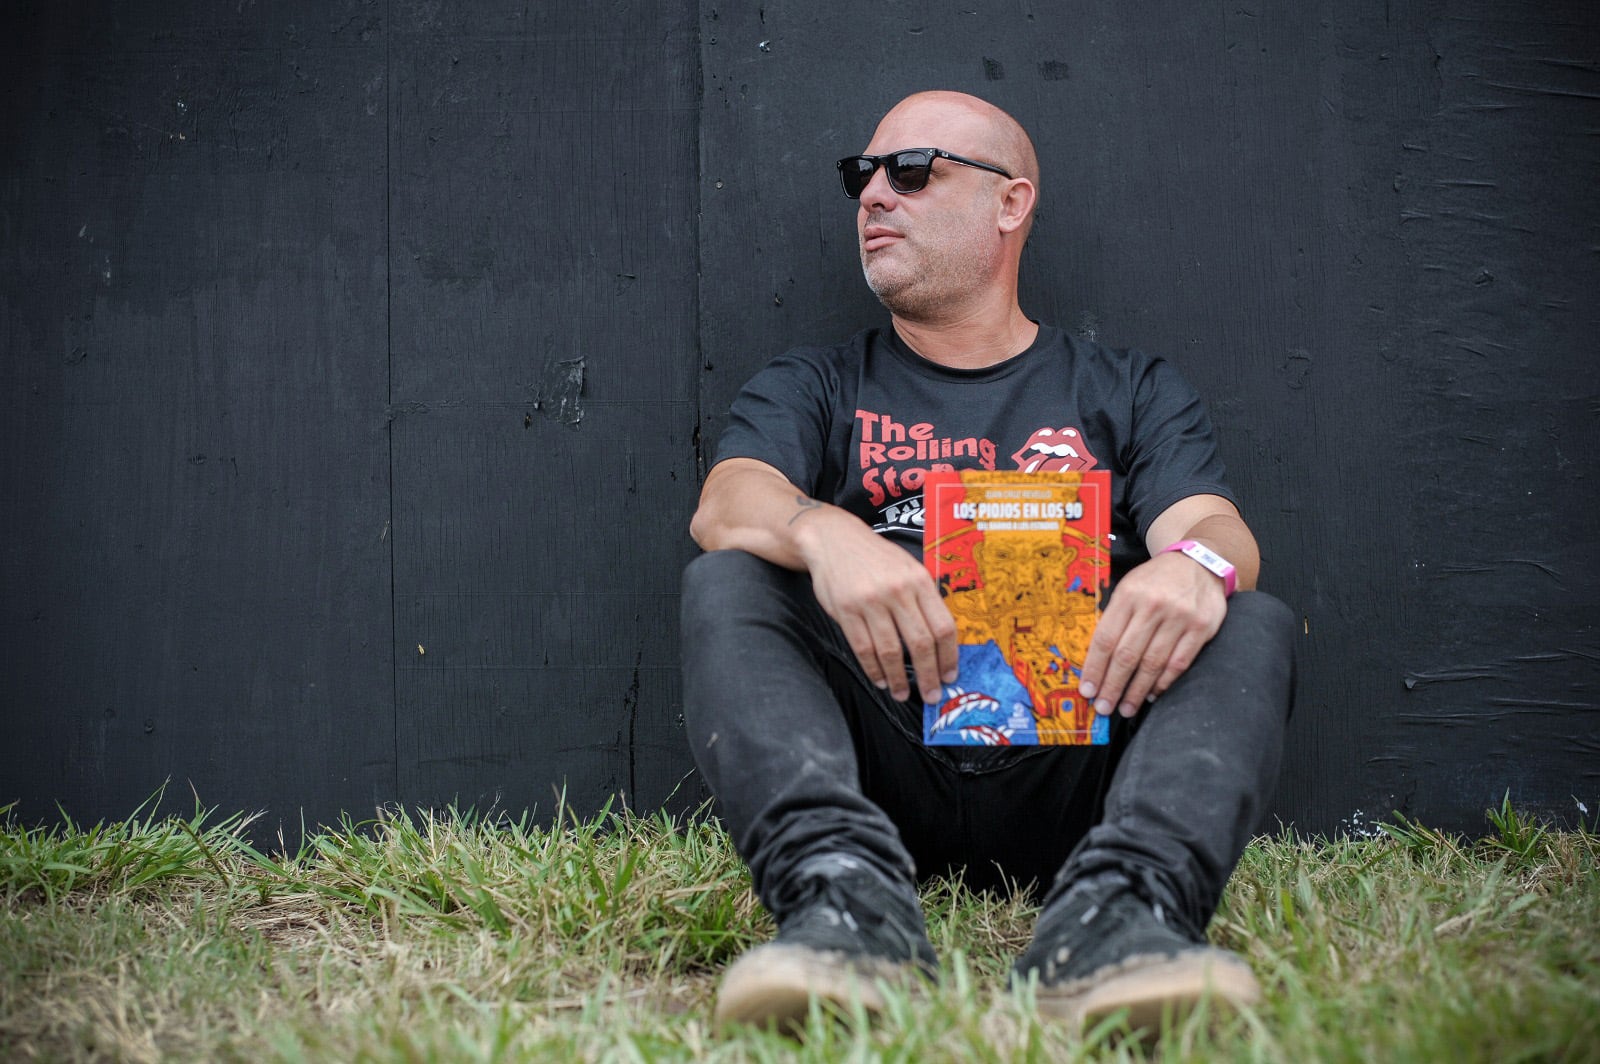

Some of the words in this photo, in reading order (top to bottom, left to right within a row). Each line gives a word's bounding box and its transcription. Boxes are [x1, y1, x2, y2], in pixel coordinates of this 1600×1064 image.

[855, 409, 935, 443] The
[859, 437, 997, 471] Rolling
[862, 463, 978, 507] Sto
[953, 502, 977, 519] LOS
[978, 502, 1021, 519] PIOJOS
[1022, 502, 1040, 519] EN
[1041, 502, 1064, 519] LOS
[1065, 502, 1083, 519] 90
